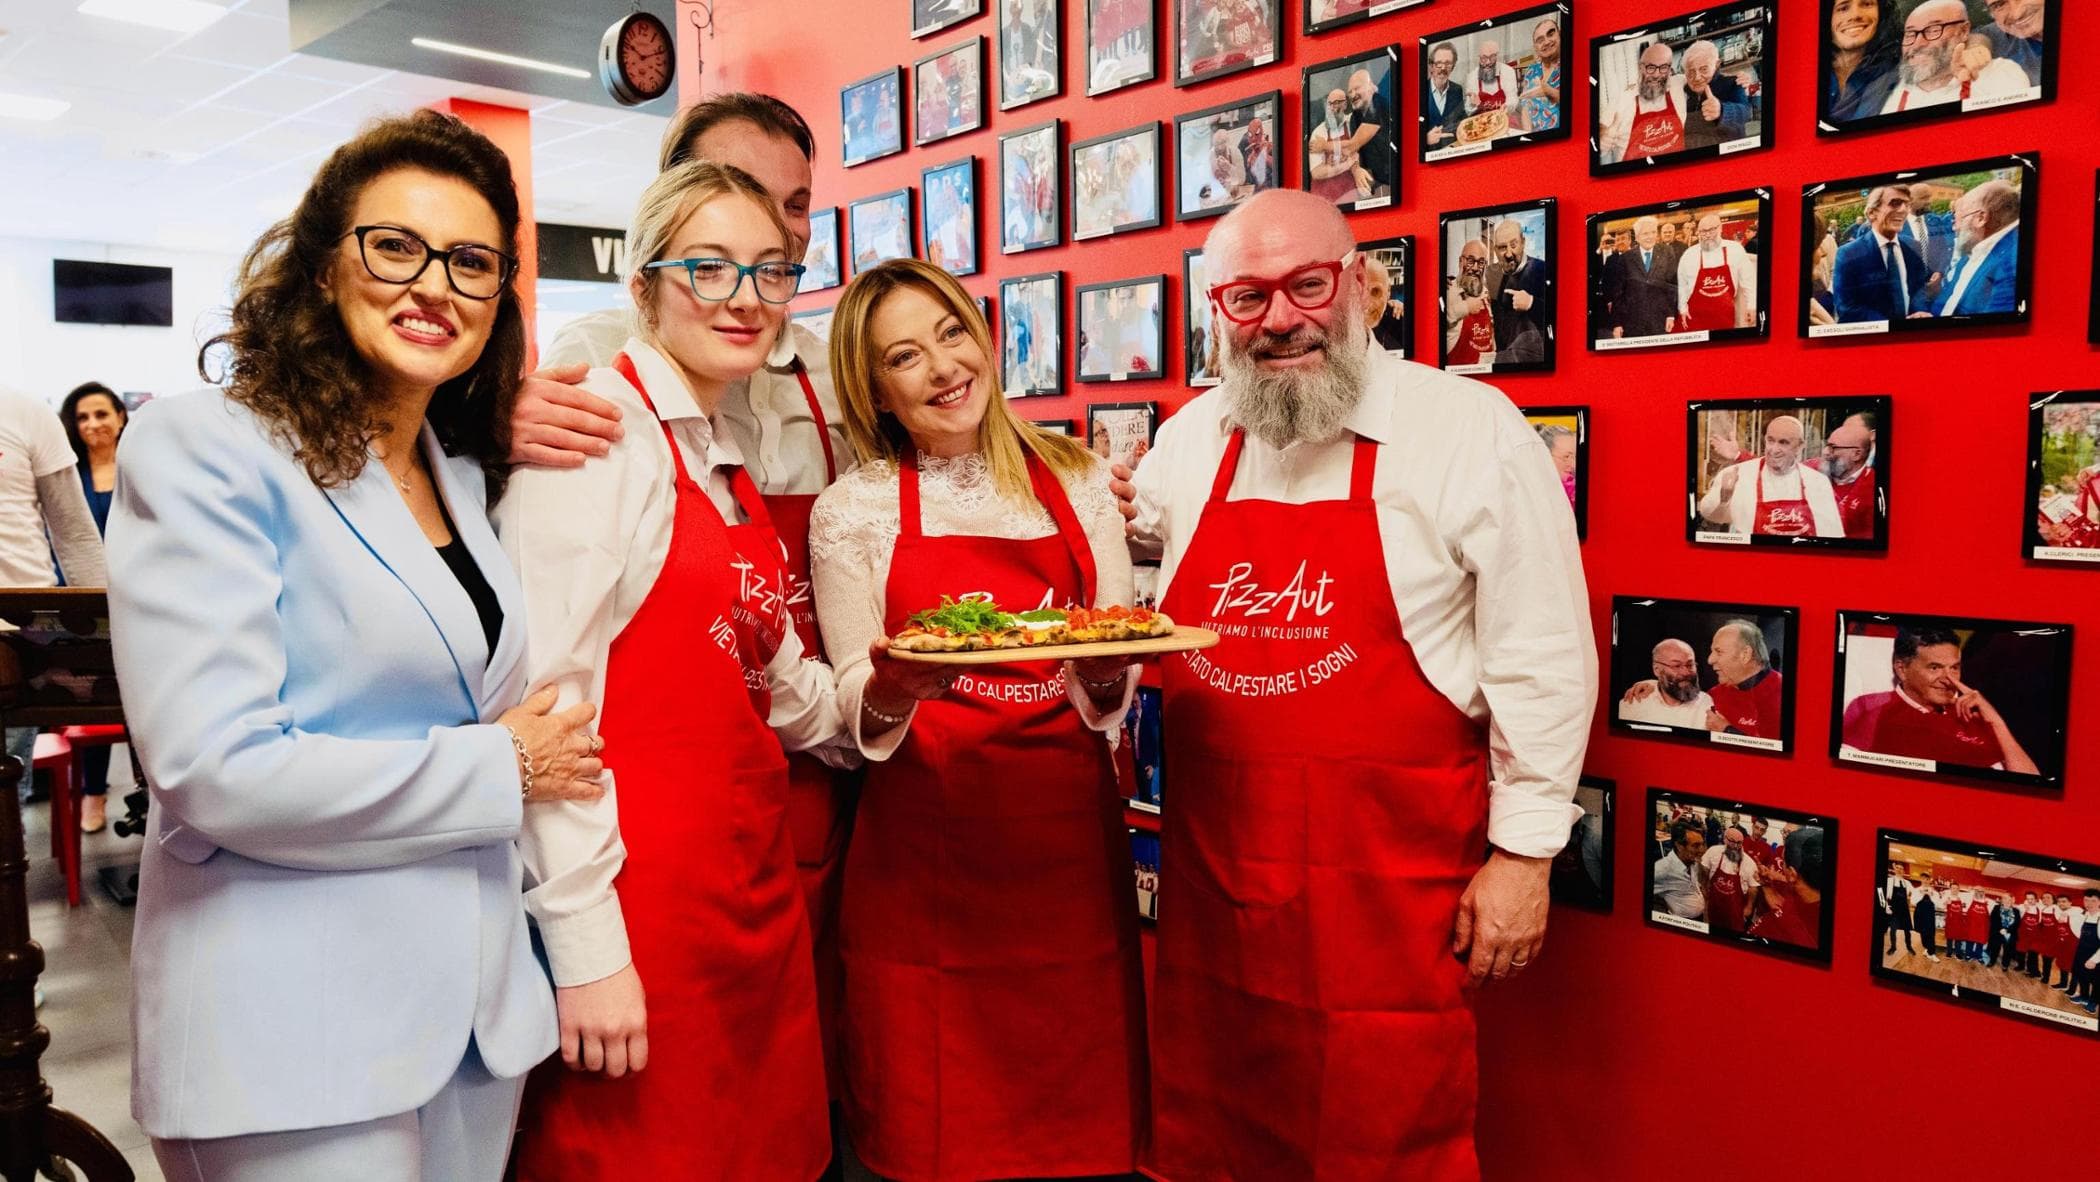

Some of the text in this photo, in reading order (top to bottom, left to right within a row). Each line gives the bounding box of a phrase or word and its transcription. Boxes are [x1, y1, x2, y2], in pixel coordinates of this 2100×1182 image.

[1208, 558, 1335, 622] PizzAut
[1251, 626, 1330, 640] L'INCLUSIONE
[1209, 667, 1298, 697] CALPESTARE
[1299, 668, 1307, 688] I
[1308, 642, 1358, 685] SOGNI
